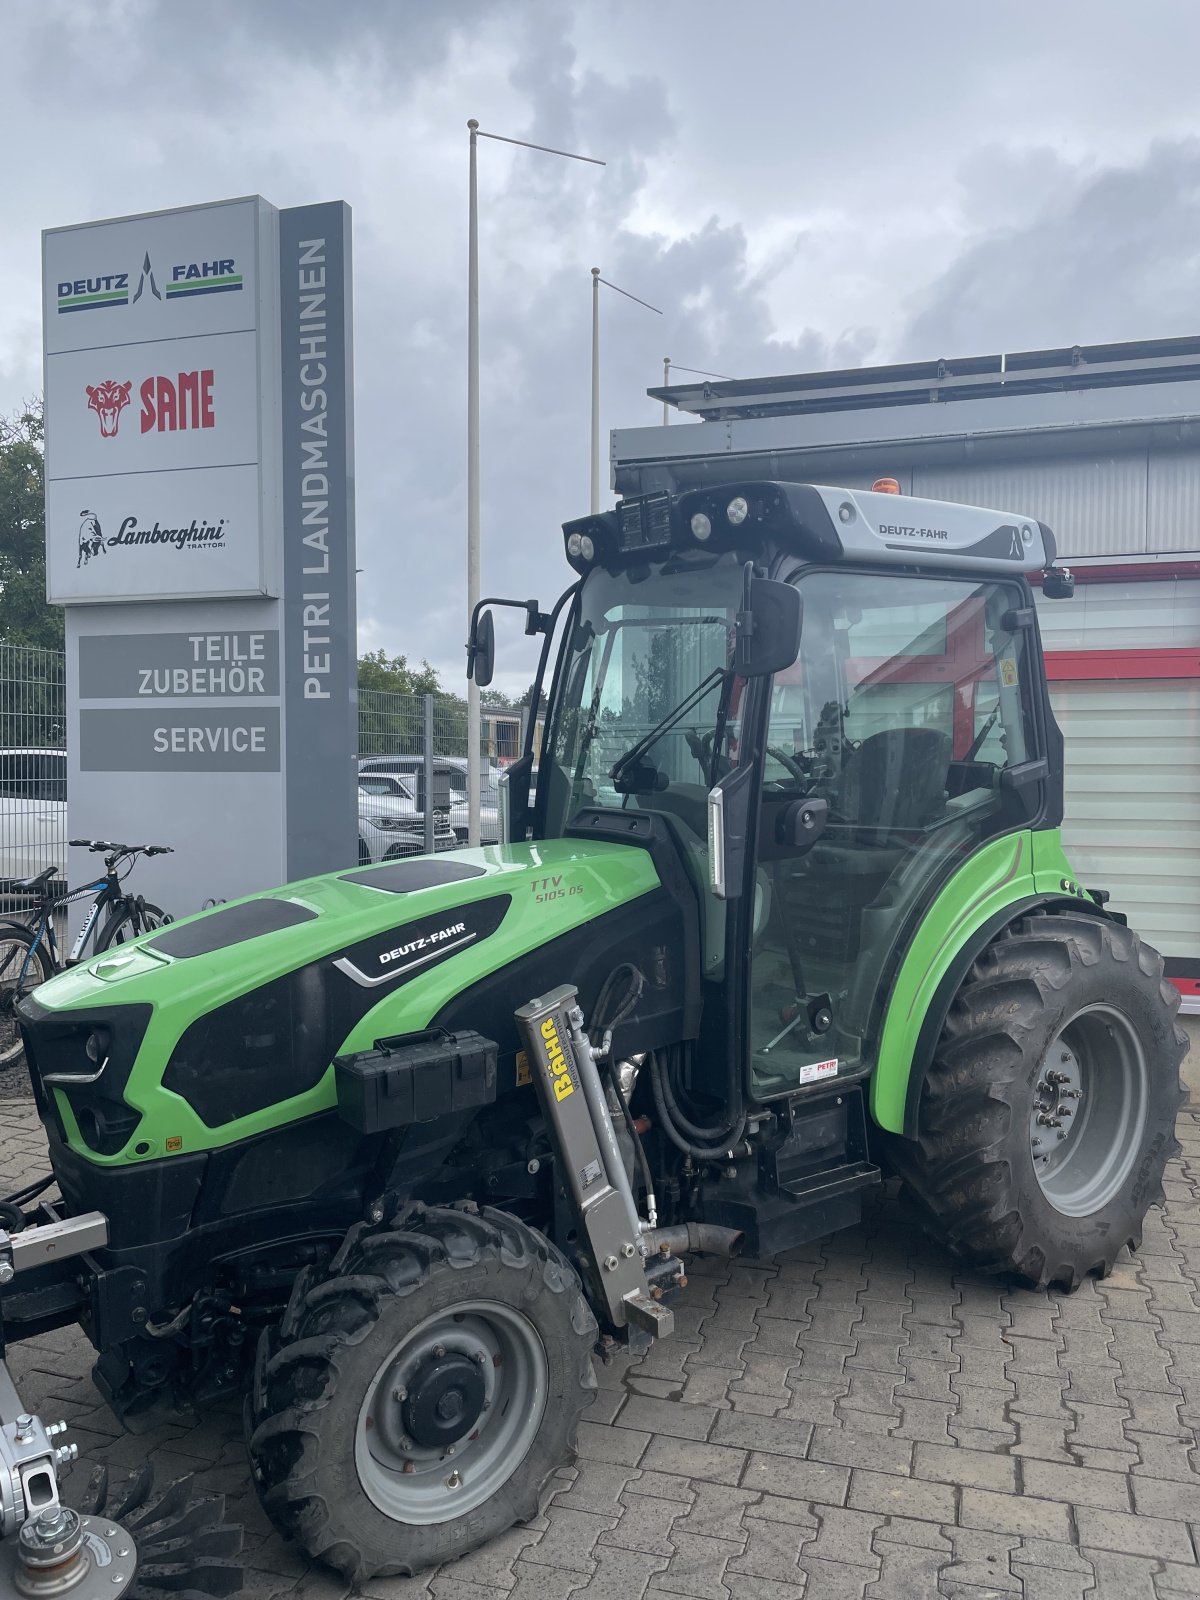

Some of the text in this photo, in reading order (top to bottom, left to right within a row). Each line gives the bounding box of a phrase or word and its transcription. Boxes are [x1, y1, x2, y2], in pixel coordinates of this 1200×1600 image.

[57, 258, 236, 298] DEUTZ FAHR
[140, 369, 215, 434] SAME
[298, 237, 331, 699] PETRI LANDMASCHINEN
[106, 516, 225, 550] Lamborghini
[187, 542, 226, 550] TRATTORI
[879, 525, 947, 540] DEUTZ-FAHR
[188, 634, 265, 662] TEILE
[138, 660, 265, 695] ZUBEHÖR
[153, 726, 267, 754] SERVICE
[530, 874, 563, 893] TTV
[379, 922, 466, 964] DEUTZ-FAHR
[540, 1017, 575, 1103] BÄHR
[553, 1012, 581, 1092] Weinbautechnik
[817, 1061, 837, 1071] PETRI
